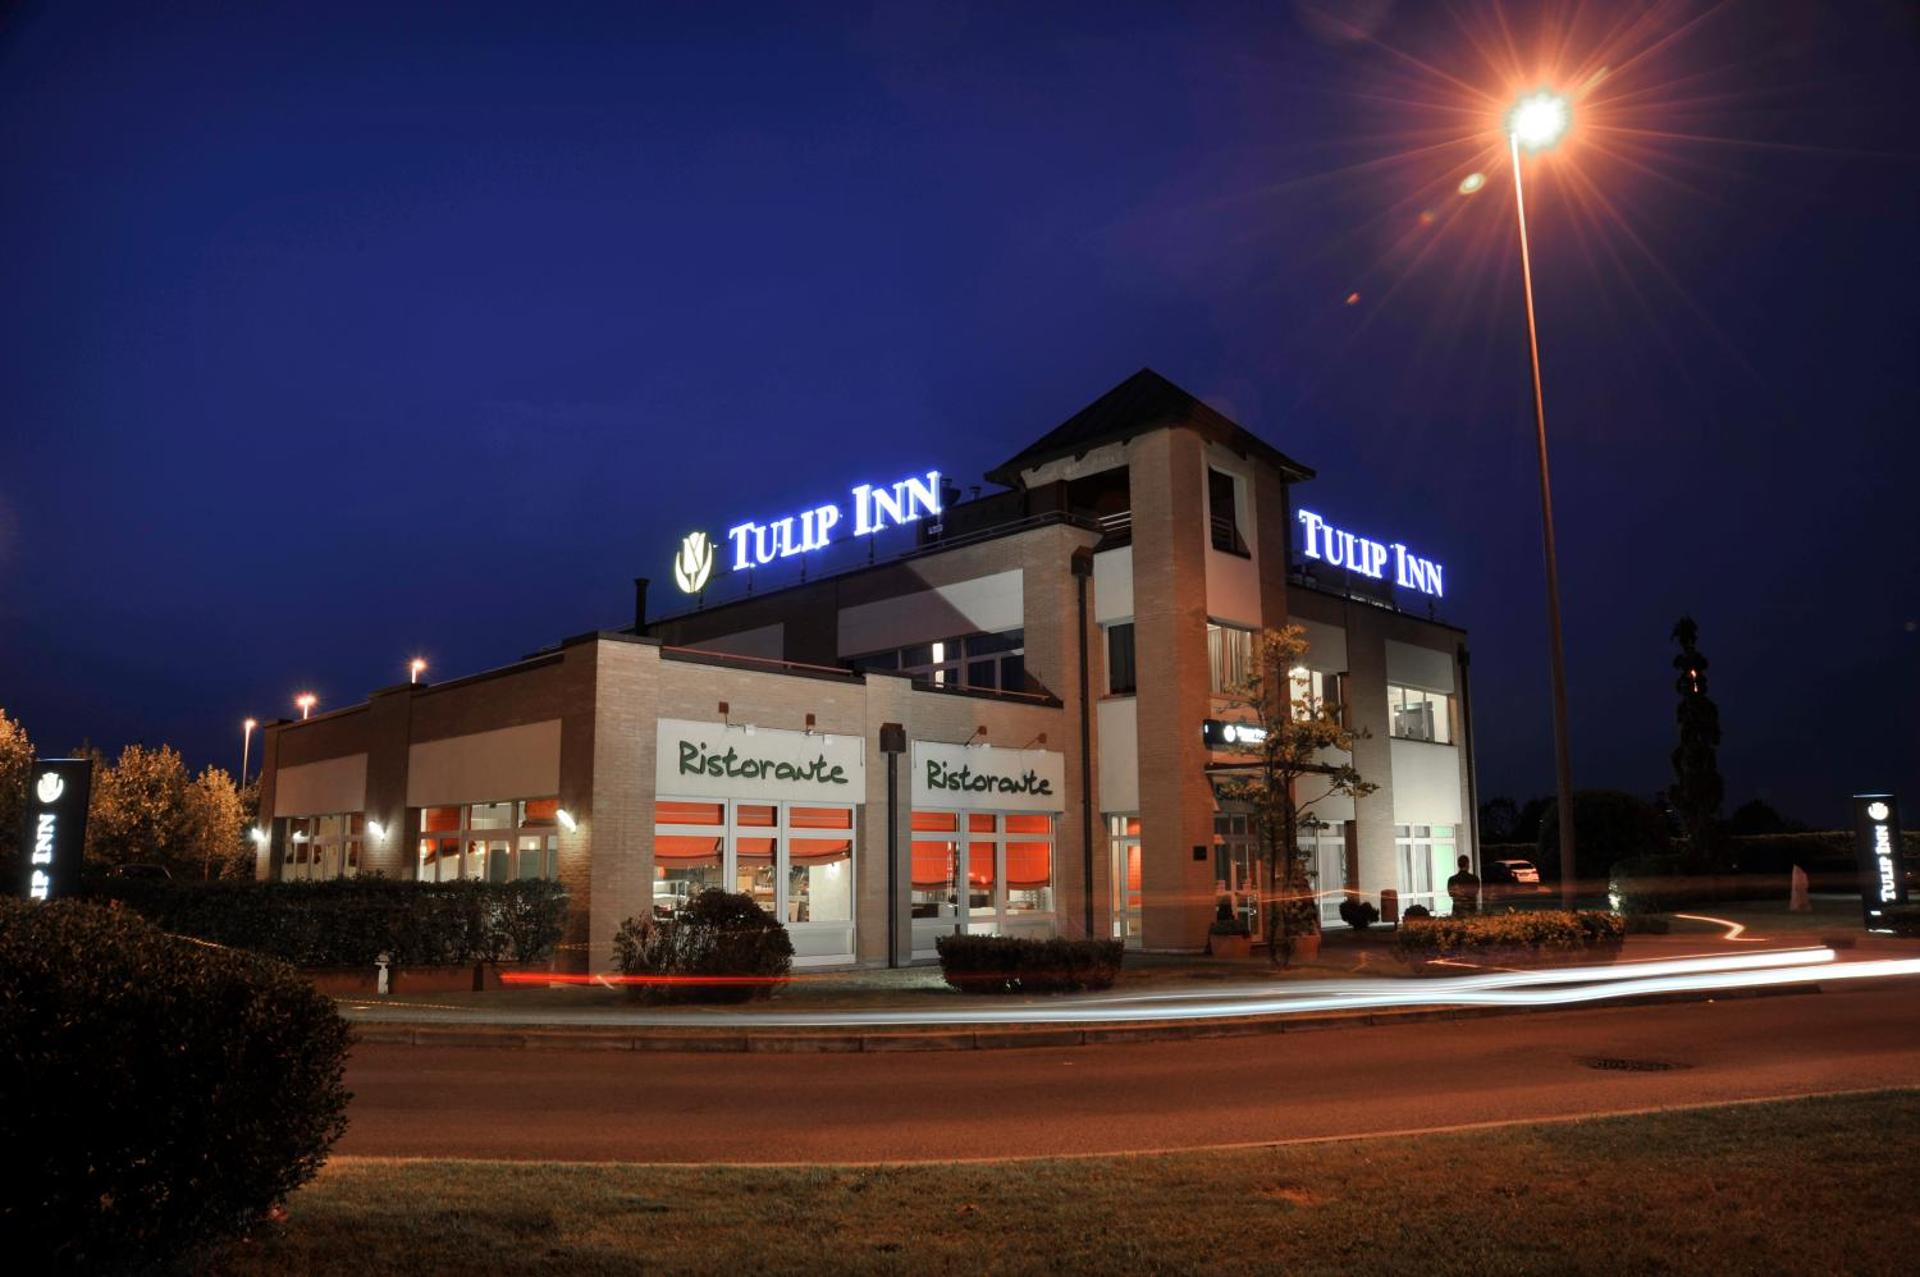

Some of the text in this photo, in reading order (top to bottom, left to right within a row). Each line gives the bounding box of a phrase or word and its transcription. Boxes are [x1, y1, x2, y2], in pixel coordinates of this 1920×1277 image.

[728, 470, 942, 571] TULIP INN
[1298, 509, 1443, 598] TULIP INN
[679, 740, 849, 785] Ristorante
[927, 759, 1053, 796] Ristorante
[31, 813, 57, 865] INN
[1879, 855, 1897, 903] TULIP
